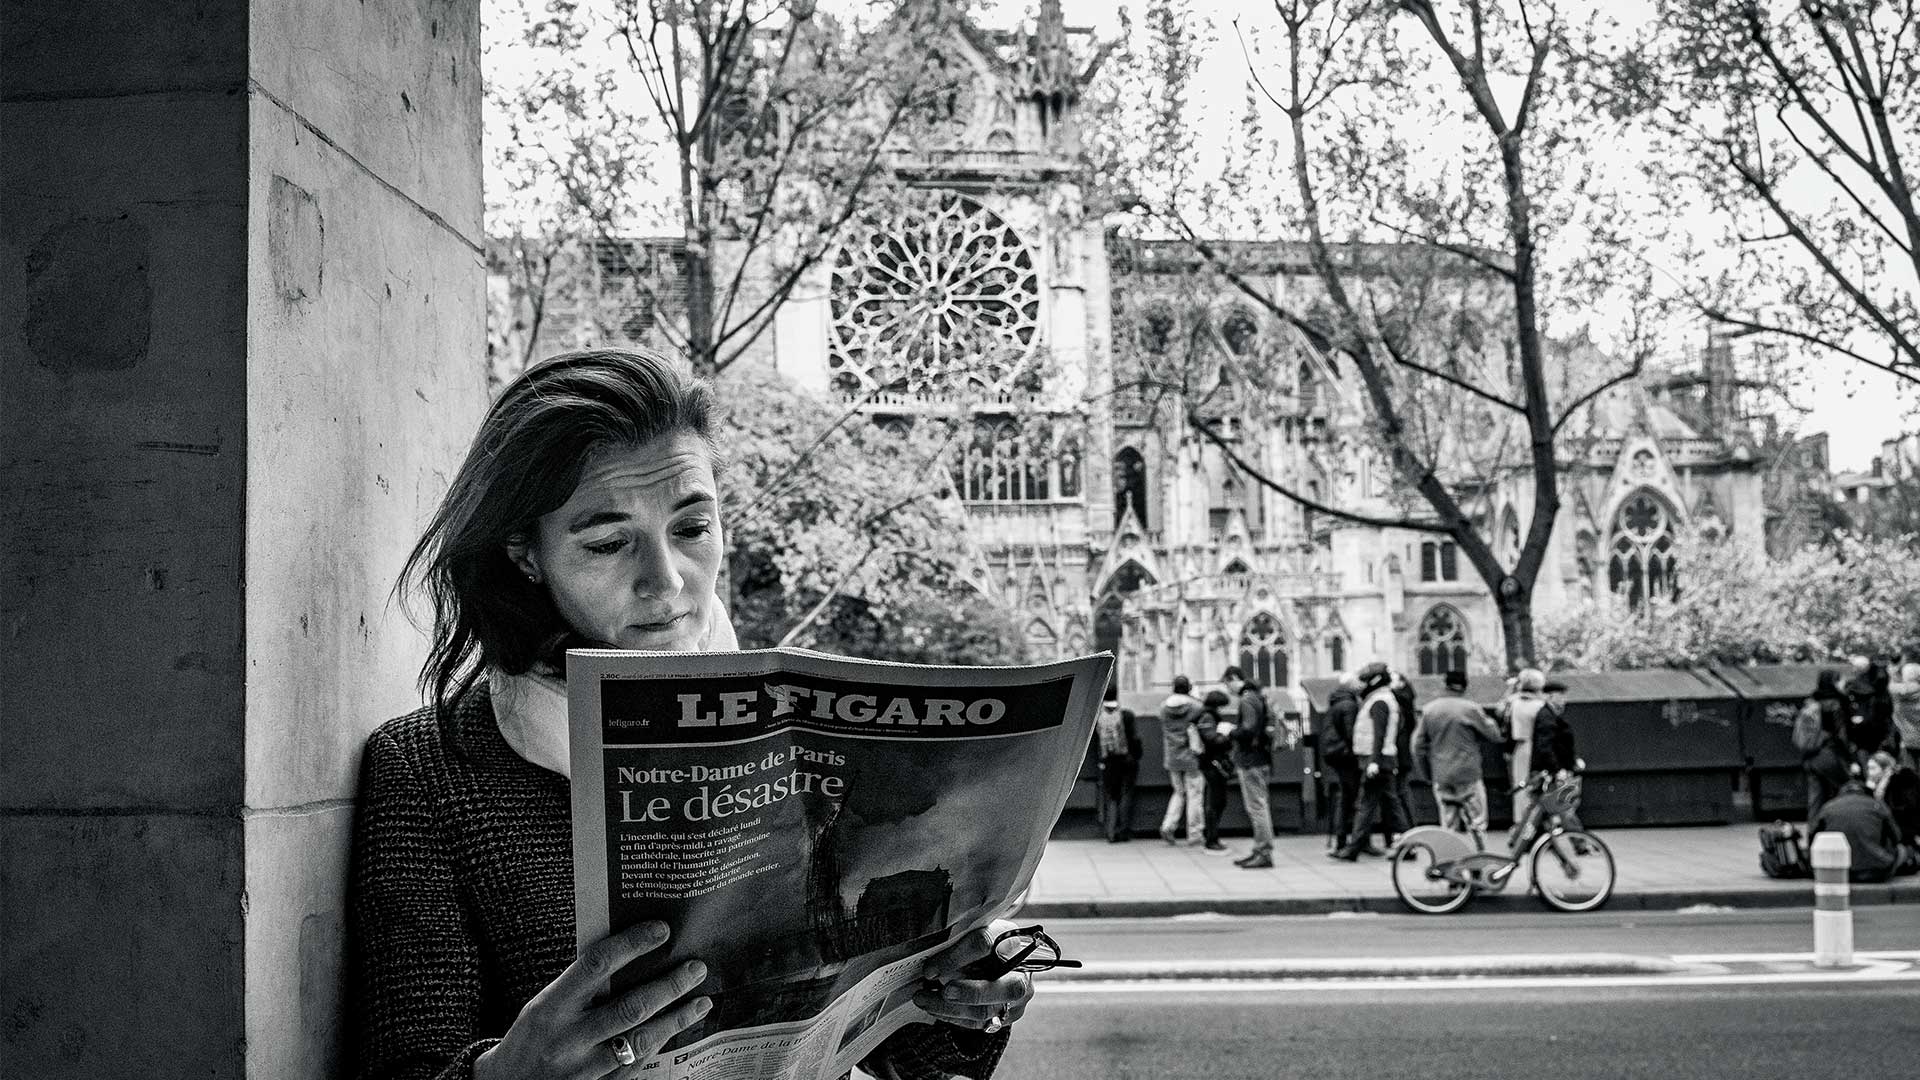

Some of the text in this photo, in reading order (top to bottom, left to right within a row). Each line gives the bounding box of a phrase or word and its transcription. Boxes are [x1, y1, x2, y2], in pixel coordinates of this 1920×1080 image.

[677, 681, 1006, 727] LE FIGARO
[608, 719, 650, 728] lefigaro.fr
[618, 745, 846, 784] Notre-Dame de Paris
[619, 768, 844, 823] Le désastre
[670, 833, 686, 842] qui
[707, 824, 738, 838] déclaré
[740, 816, 761, 830] lundi
[620, 852, 630, 861] la
[682, 848, 715, 860] inscrite
[716, 847, 727, 855] au
[728, 832, 771, 852] patrimoine
[633, 842, 646, 851] fin
[621, 861, 658, 870] mondial
[659, 861, 671, 870] de
[621, 871, 654, 880] Devant
[655, 872, 666, 880] ce
[667, 868, 707, 881] spectacle
[708, 866, 719, 875] de
[621, 867, 741, 891] les témoignages de solidarité
[621, 891, 631, 899] et
[632, 890, 644, 898] de
[645, 890, 682, 898] tristesse
[716, 881, 727, 889] du
[728, 870, 755, 884] monde
[760, 1040, 777, 1050] de
[778, 1039, 791, 1047] la
